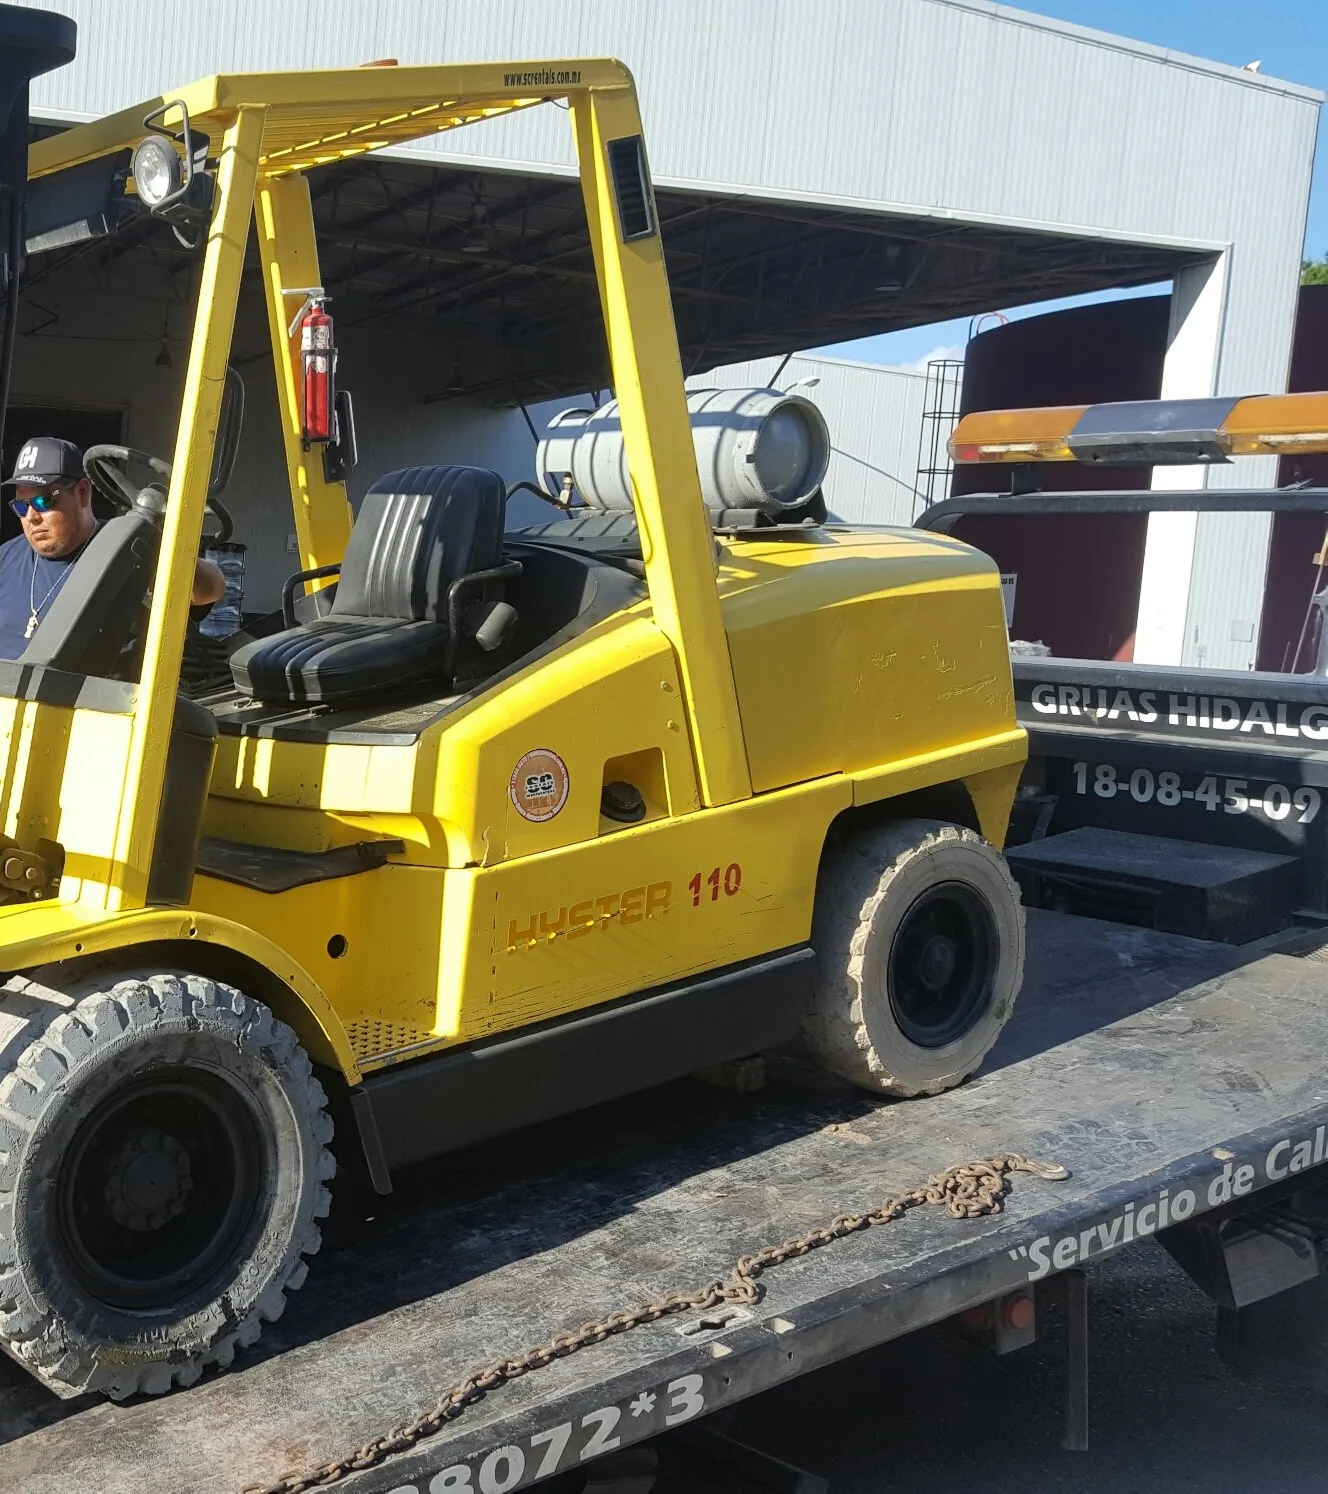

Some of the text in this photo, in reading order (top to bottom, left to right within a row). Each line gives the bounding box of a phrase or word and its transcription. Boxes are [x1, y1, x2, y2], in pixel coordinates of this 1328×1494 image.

[504, 68, 582, 87] www.screntals.com.mx
[1031, 684, 1158, 723] GRUAS
[1073, 761, 1321, 824] 18-08-45-09
[507, 862, 742, 956] HYSTER 110
[1207, 1162, 1255, 1207] de
[1265, 1125, 1328, 1181] Cal
[387, 1374, 705, 1494] 80723
